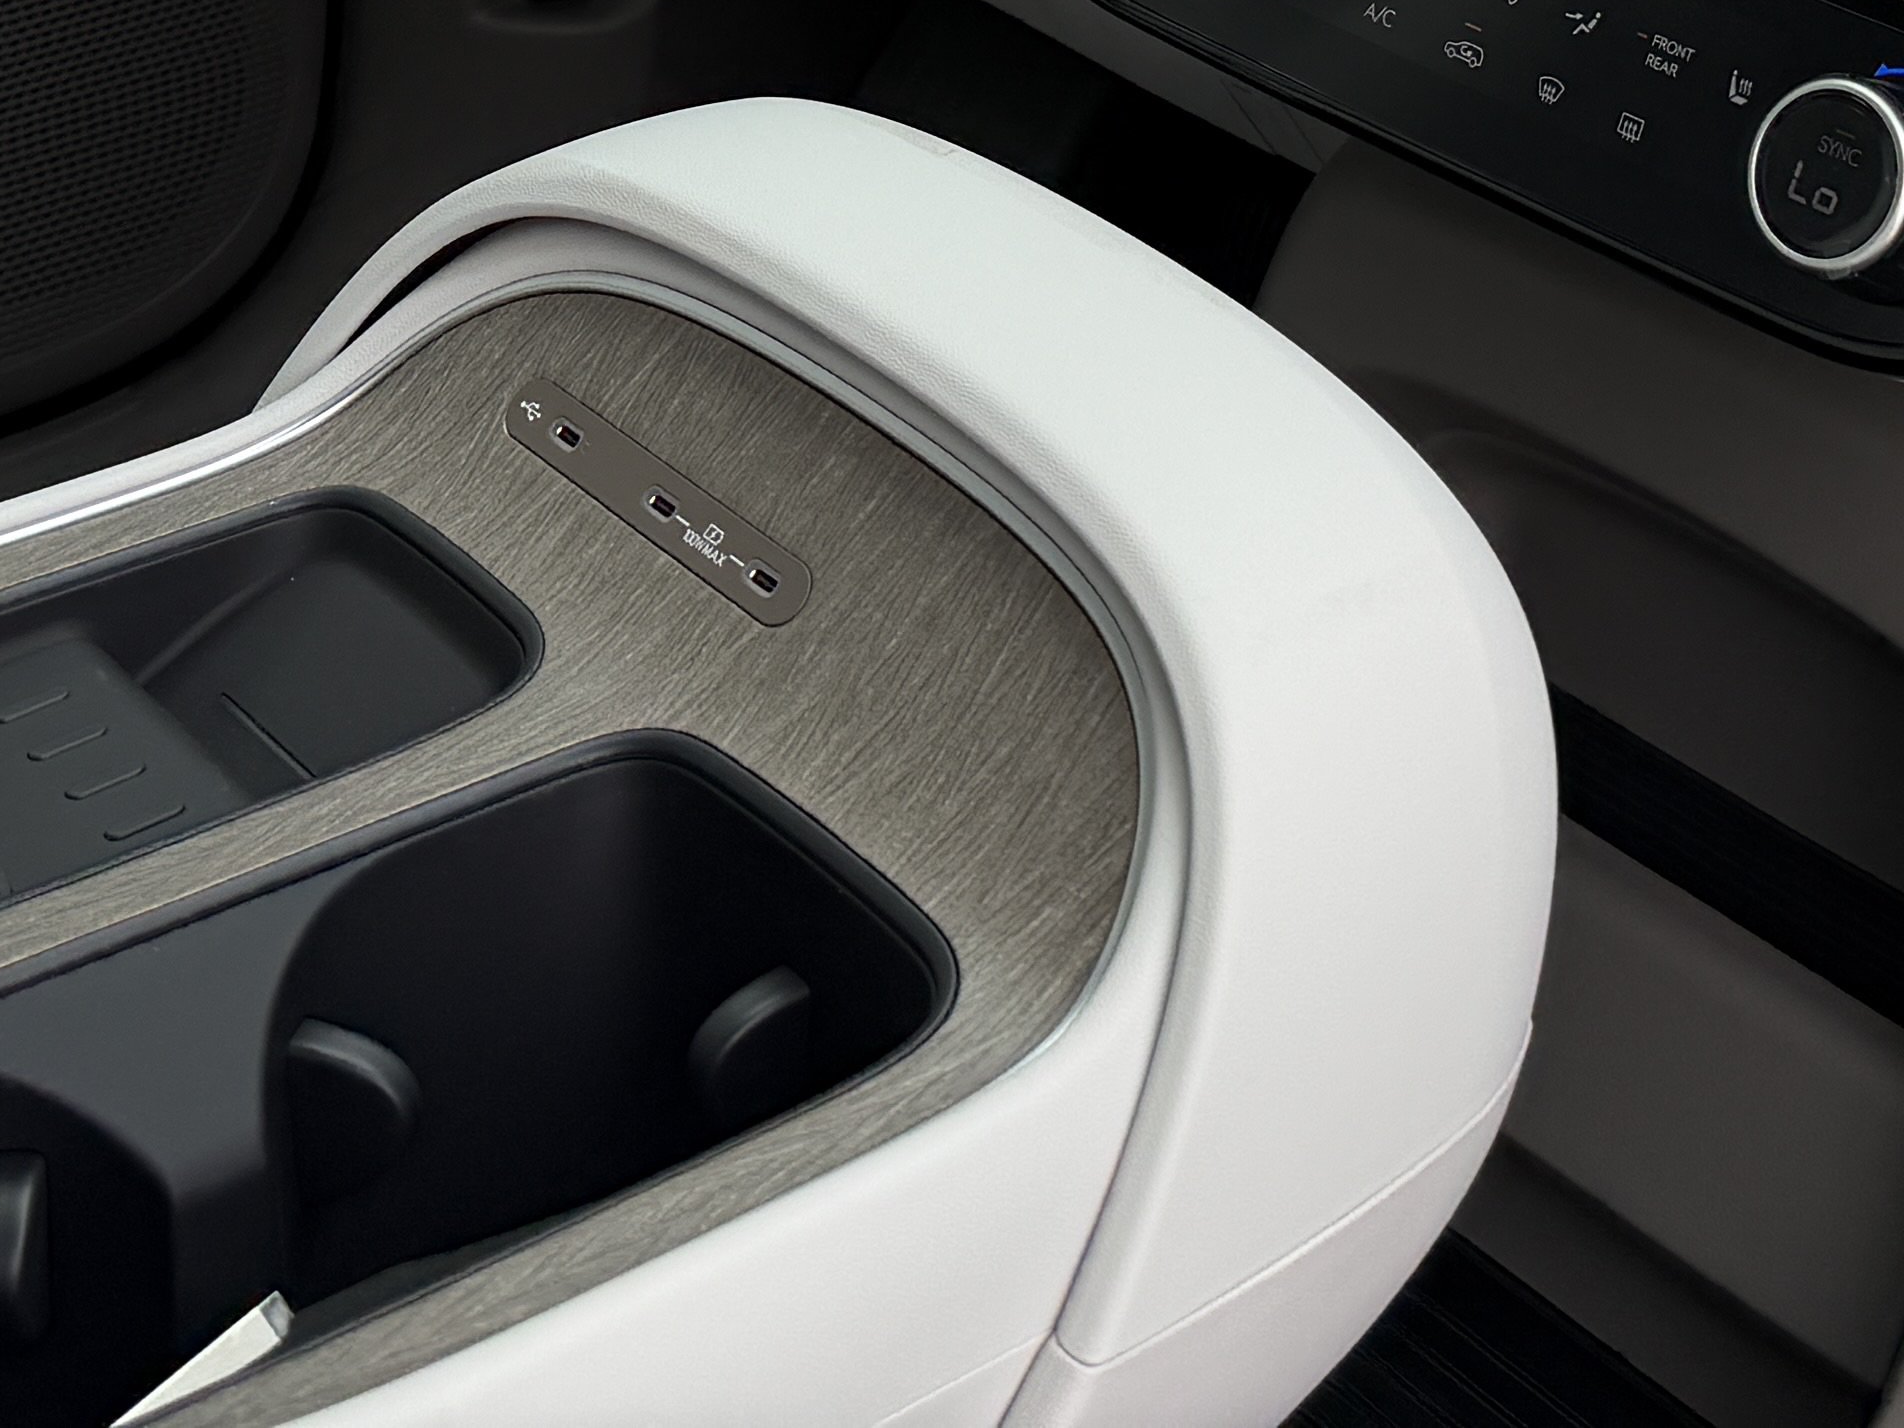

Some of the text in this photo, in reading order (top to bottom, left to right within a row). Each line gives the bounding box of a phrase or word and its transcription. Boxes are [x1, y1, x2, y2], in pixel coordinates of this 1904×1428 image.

[1363, 2, 1397, 29] A/C
[1650, 33, 1696, 63] FRONT
[1644, 52, 1679, 78] REAR
[1816, 133, 1862, 169] SYNC
